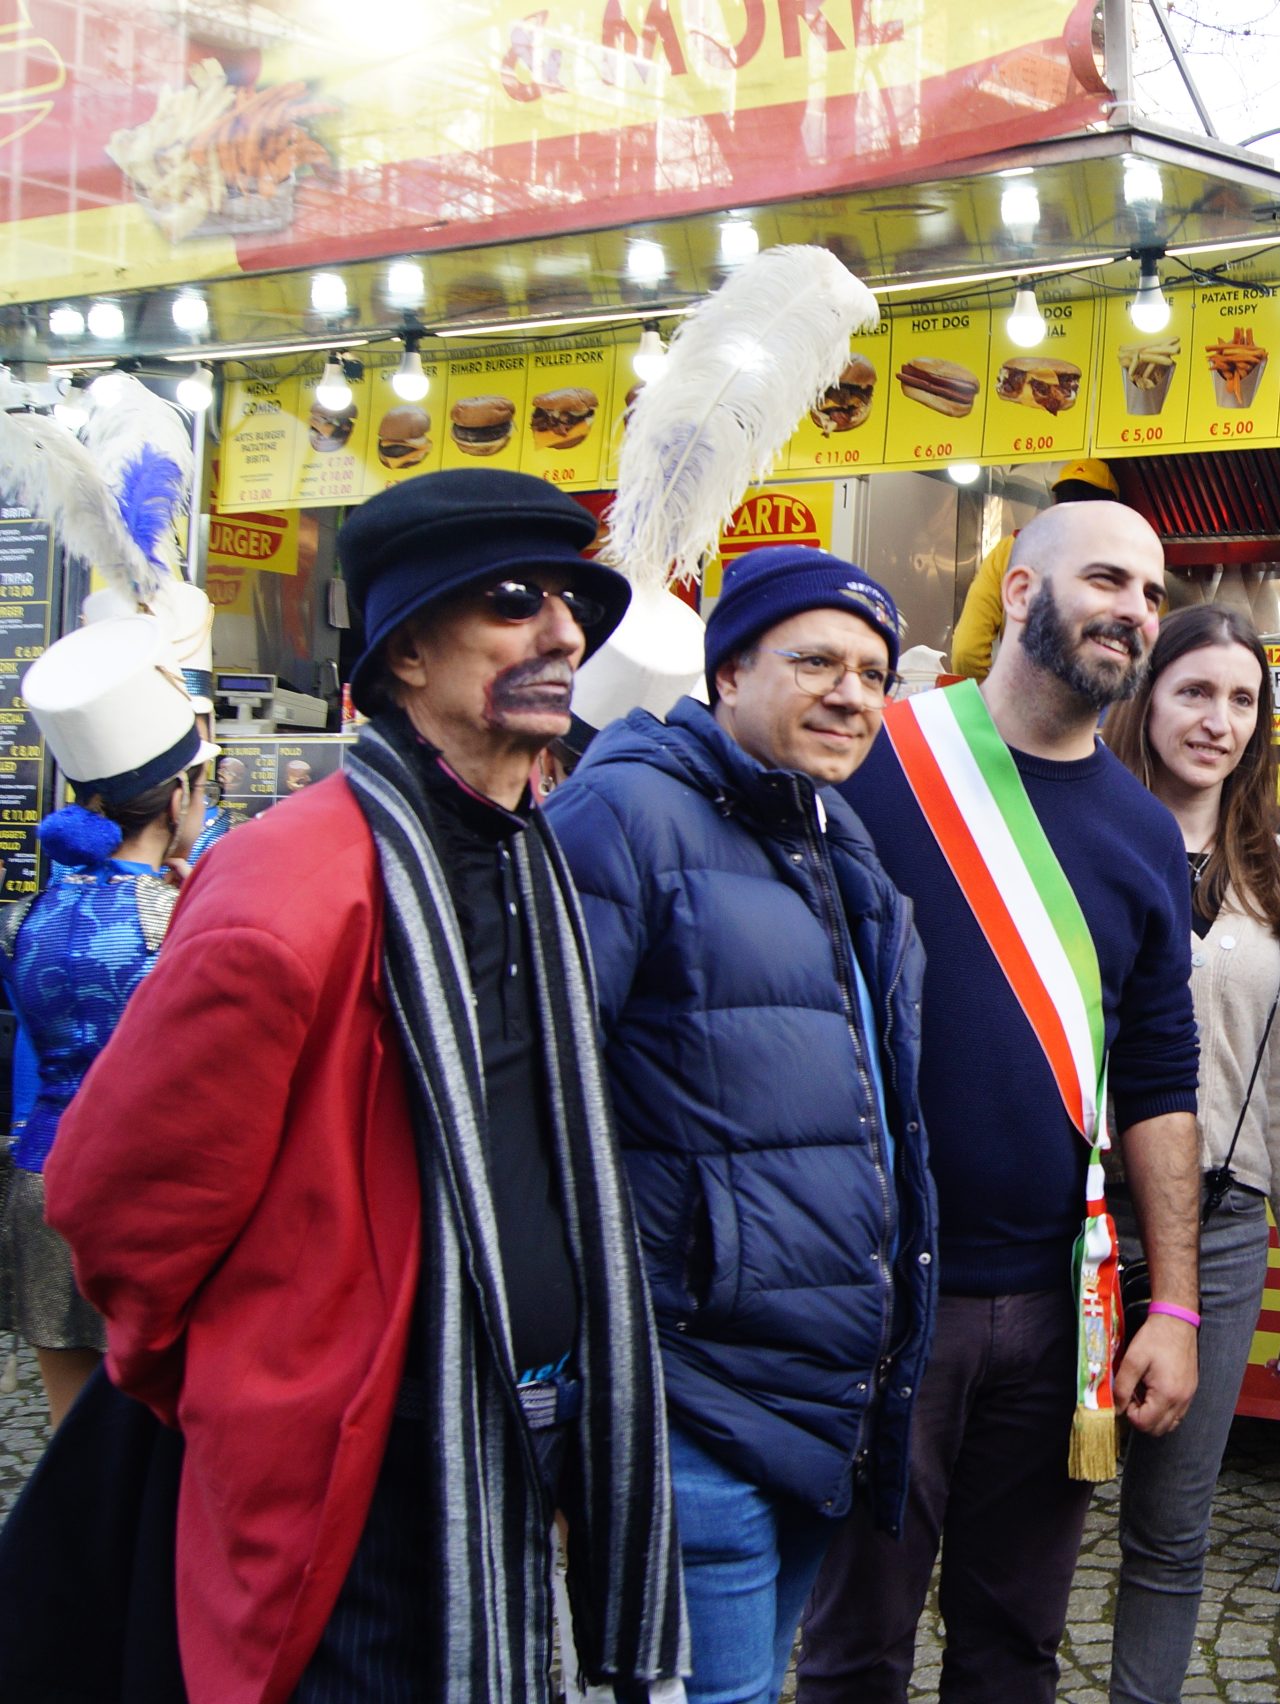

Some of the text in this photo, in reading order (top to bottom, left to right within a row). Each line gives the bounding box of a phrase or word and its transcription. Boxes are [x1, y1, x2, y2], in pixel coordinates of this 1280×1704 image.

[1201, 290, 1239, 304] PATATE
[1043, 305, 1073, 319] DOG
[1219, 304, 1258, 316] CRISPY
[852, 322, 889, 337] ULLED
[912, 315, 970, 332] HOT DOG
[450, 357, 526, 376] BIMBO BURGER
[534, 351, 604, 368] PULLED PORK
[1120, 427, 1163, 443] € 5,00
[1209, 420, 1254, 437] € 5,00
[914, 443, 953, 459] € 6,00
[1013, 436, 1054, 452] € 8,00
[815, 450, 860, 465] € 11,00
[552, 468, 575, 483] 8,00
[733, 496, 807, 536] ARTS
[208, 524, 272, 556] URGER
